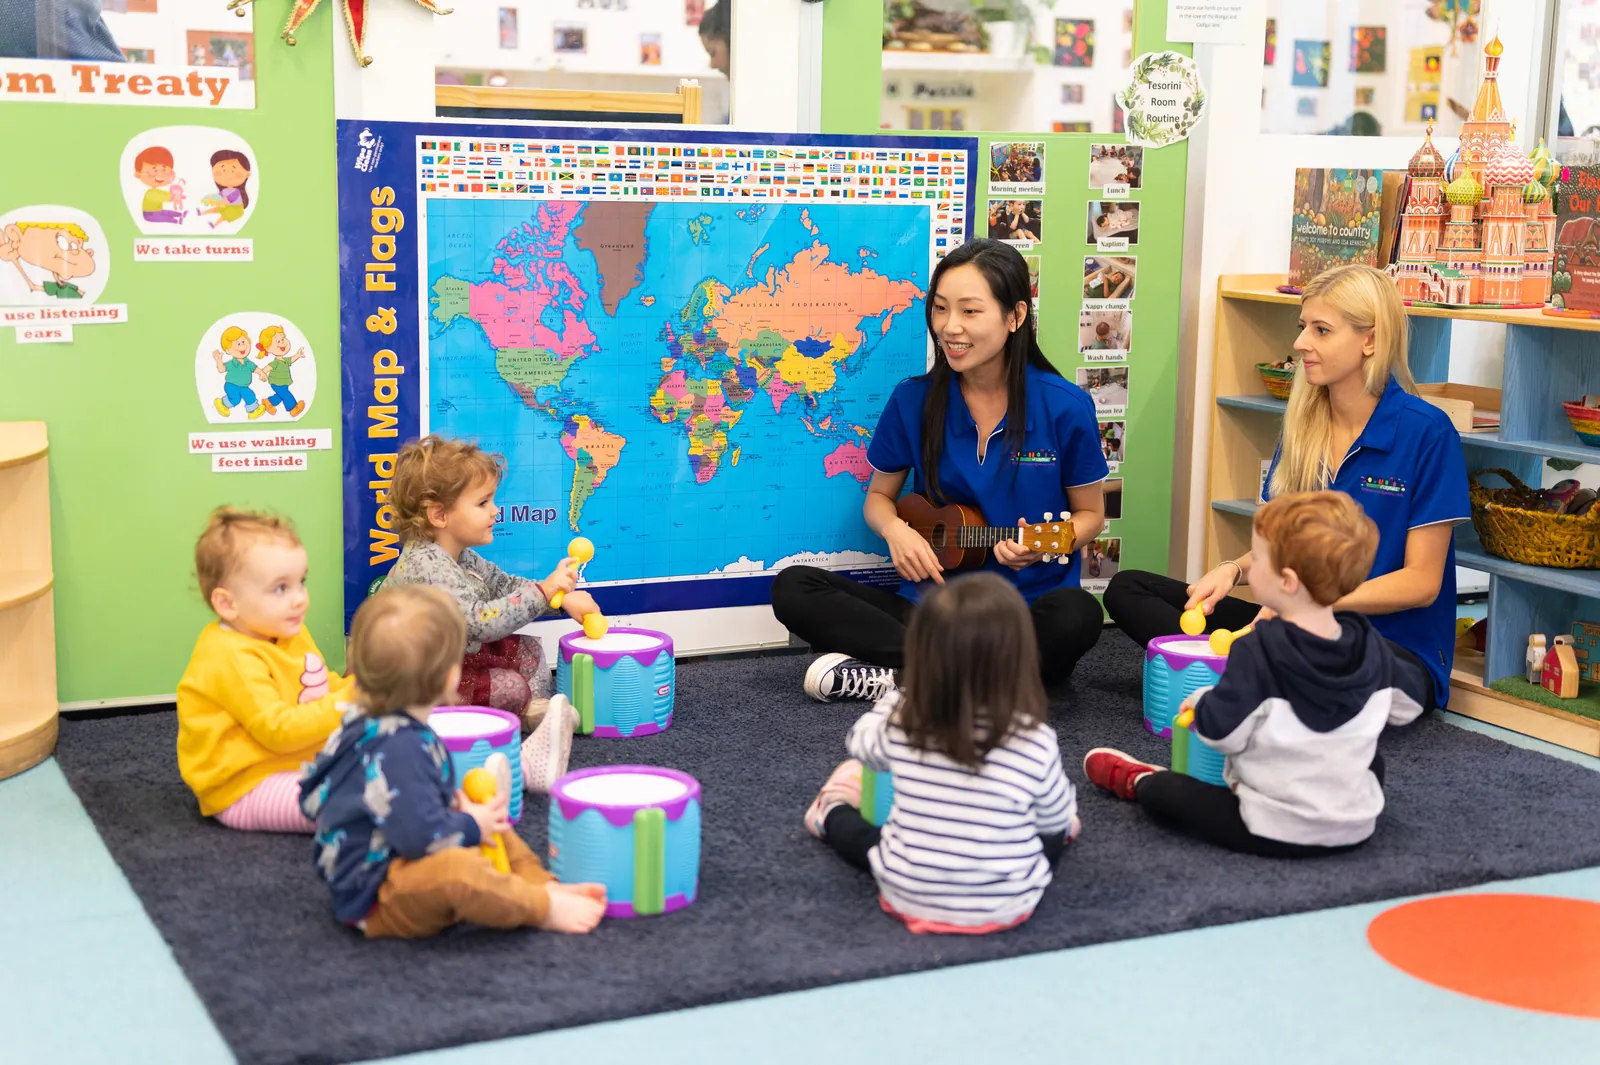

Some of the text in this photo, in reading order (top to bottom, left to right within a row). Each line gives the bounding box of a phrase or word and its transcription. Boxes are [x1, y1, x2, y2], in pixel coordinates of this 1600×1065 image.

[0, 64, 230, 106] m Treaty
[1148, 81, 1182, 90] Tesorini
[1151, 98, 1176, 106] Room
[1146, 114, 1180, 122] Routine
[354, 148, 366, 169] Wipe
[1570, 194, 1592, 212] Our
[1296, 222, 1370, 239] welcome to country
[136, 244, 250, 255] We take turns
[4, 307, 119, 320] use listening
[24, 329, 62, 338] ears
[365, 186, 405, 566] World Map & Flags
[191, 436, 316, 449] We use walking
[218, 456, 303, 467] feet inside
[512, 505, 556, 525] Map
